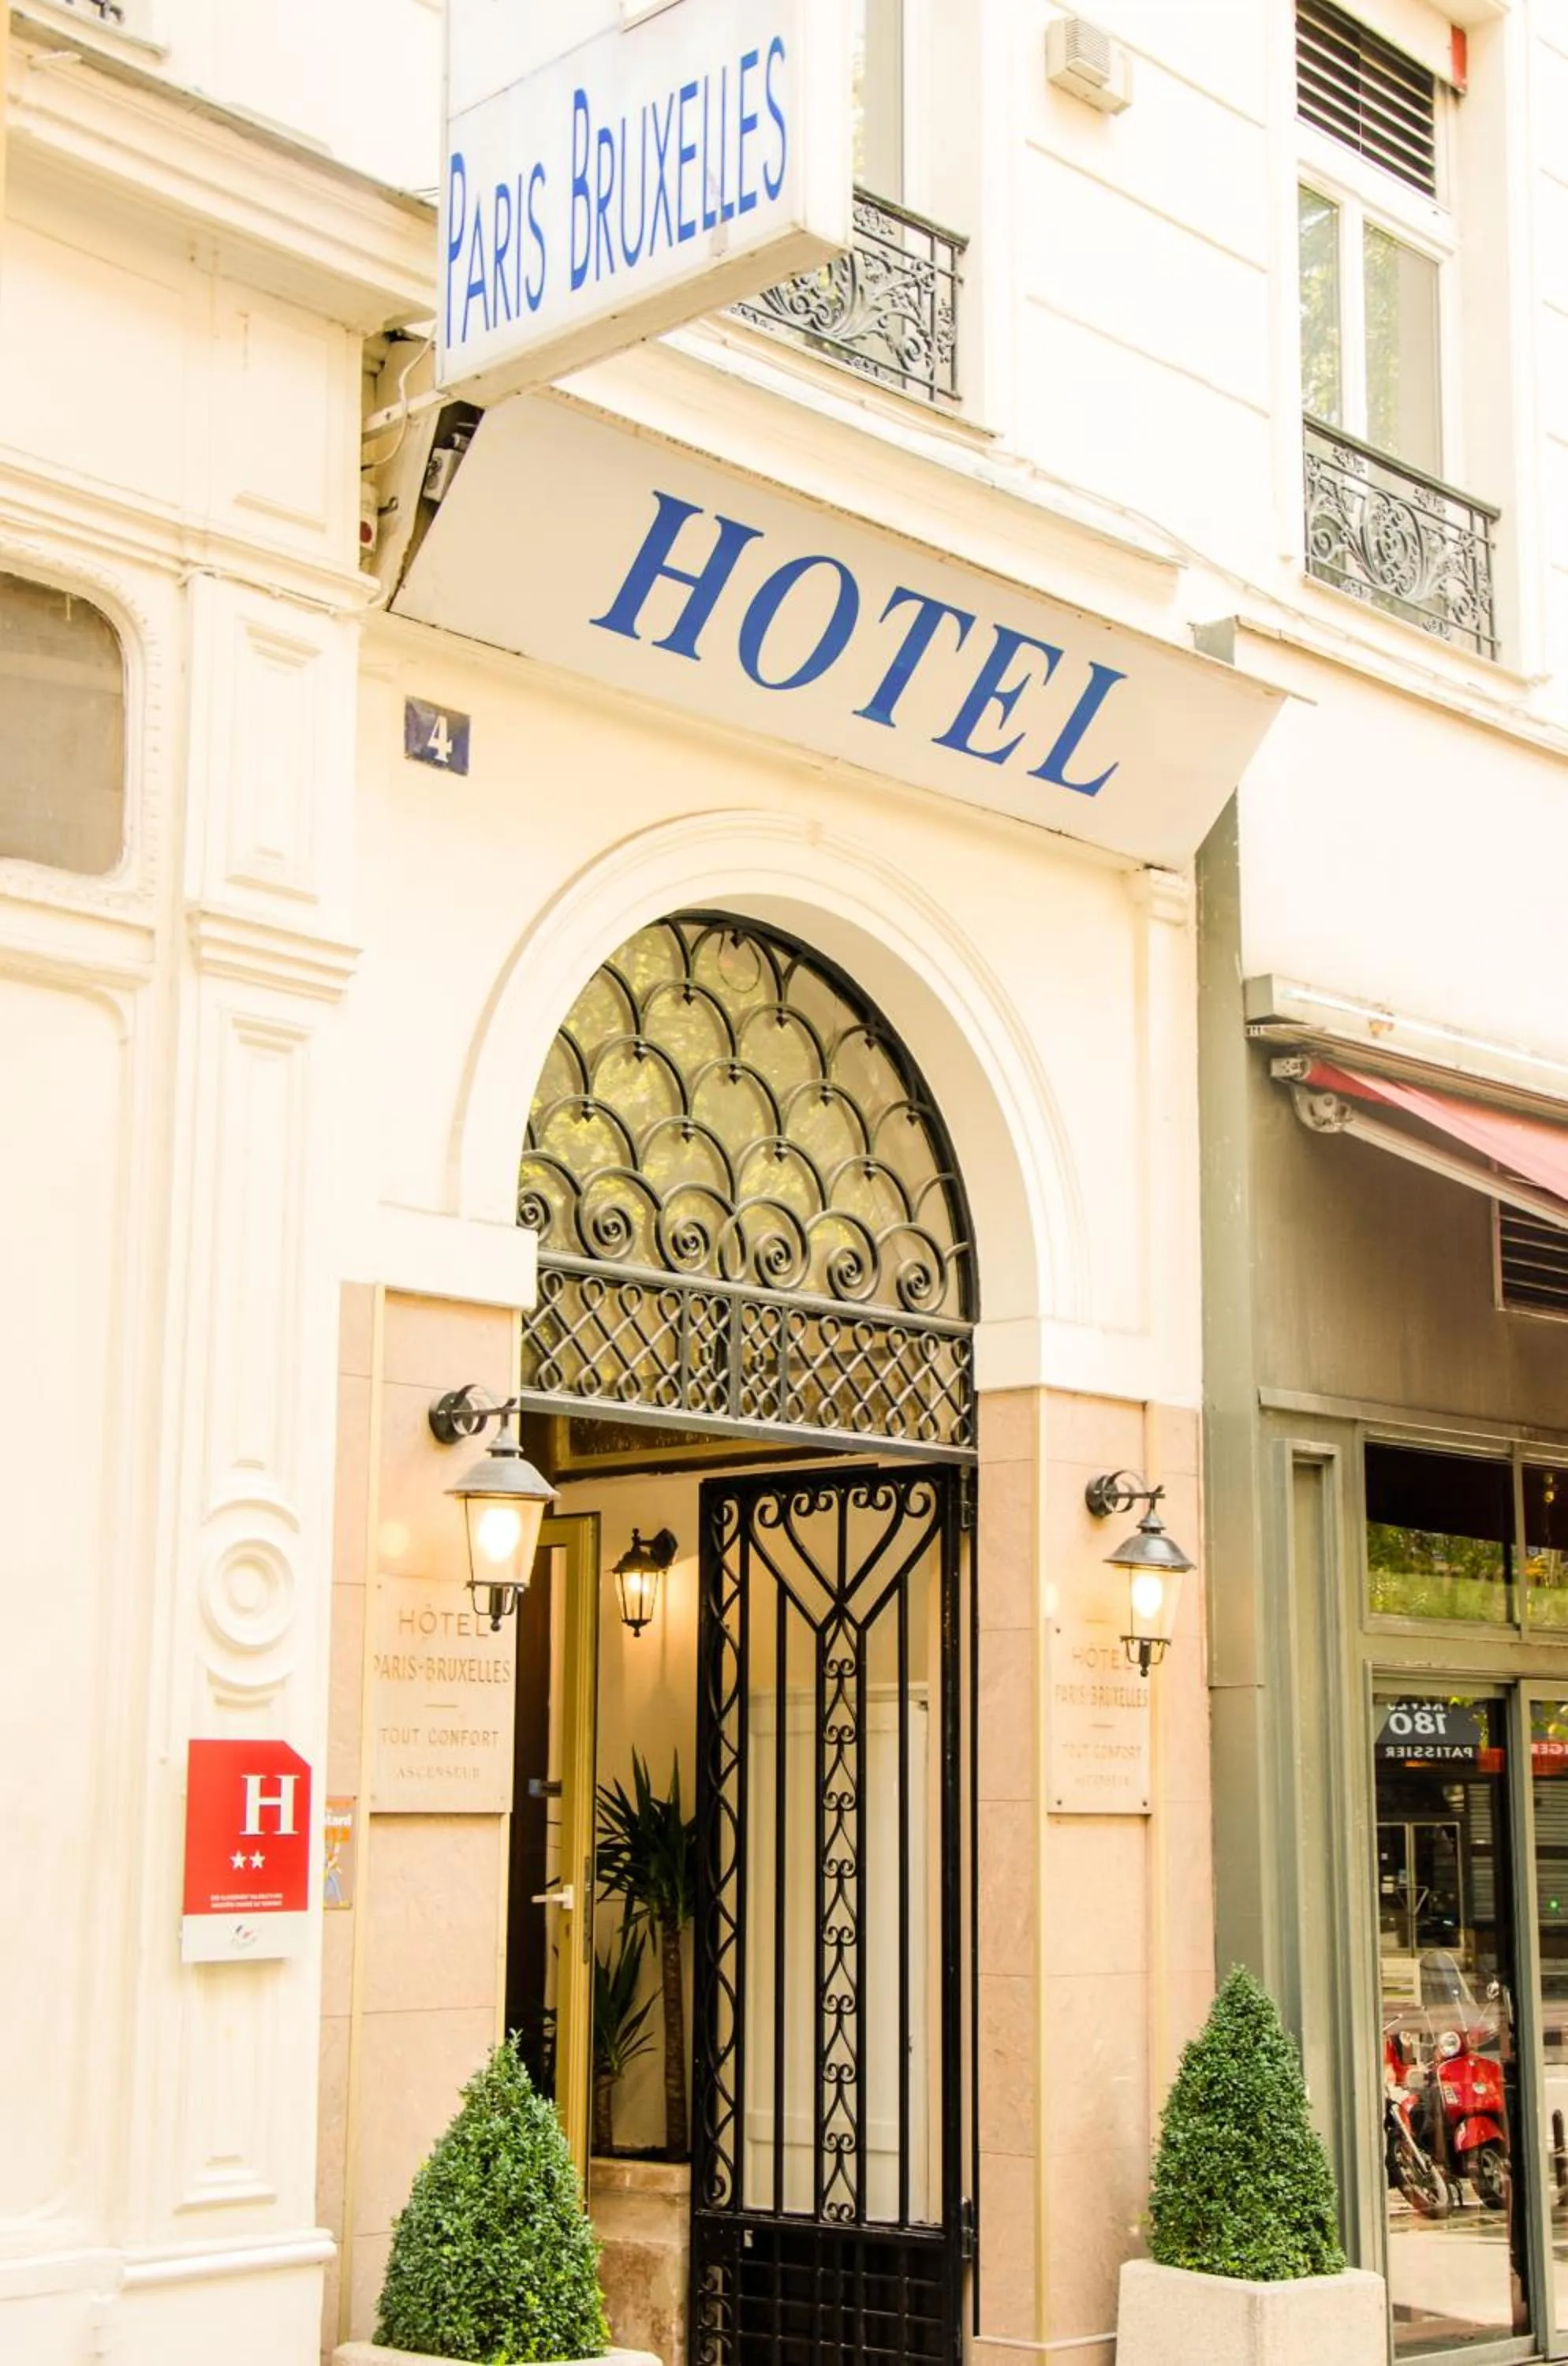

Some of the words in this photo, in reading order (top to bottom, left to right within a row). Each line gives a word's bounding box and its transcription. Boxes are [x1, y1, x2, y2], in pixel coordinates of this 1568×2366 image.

[590, 491, 1128, 797] HOTEL
[427, 715, 453, 763] 4
[398, 1605, 488, 1639] HÔTEL
[379, 1728, 420, 1746] TOUT
[427, 1729, 499, 1748] CONFORT
[240, 1774, 301, 1835] H
